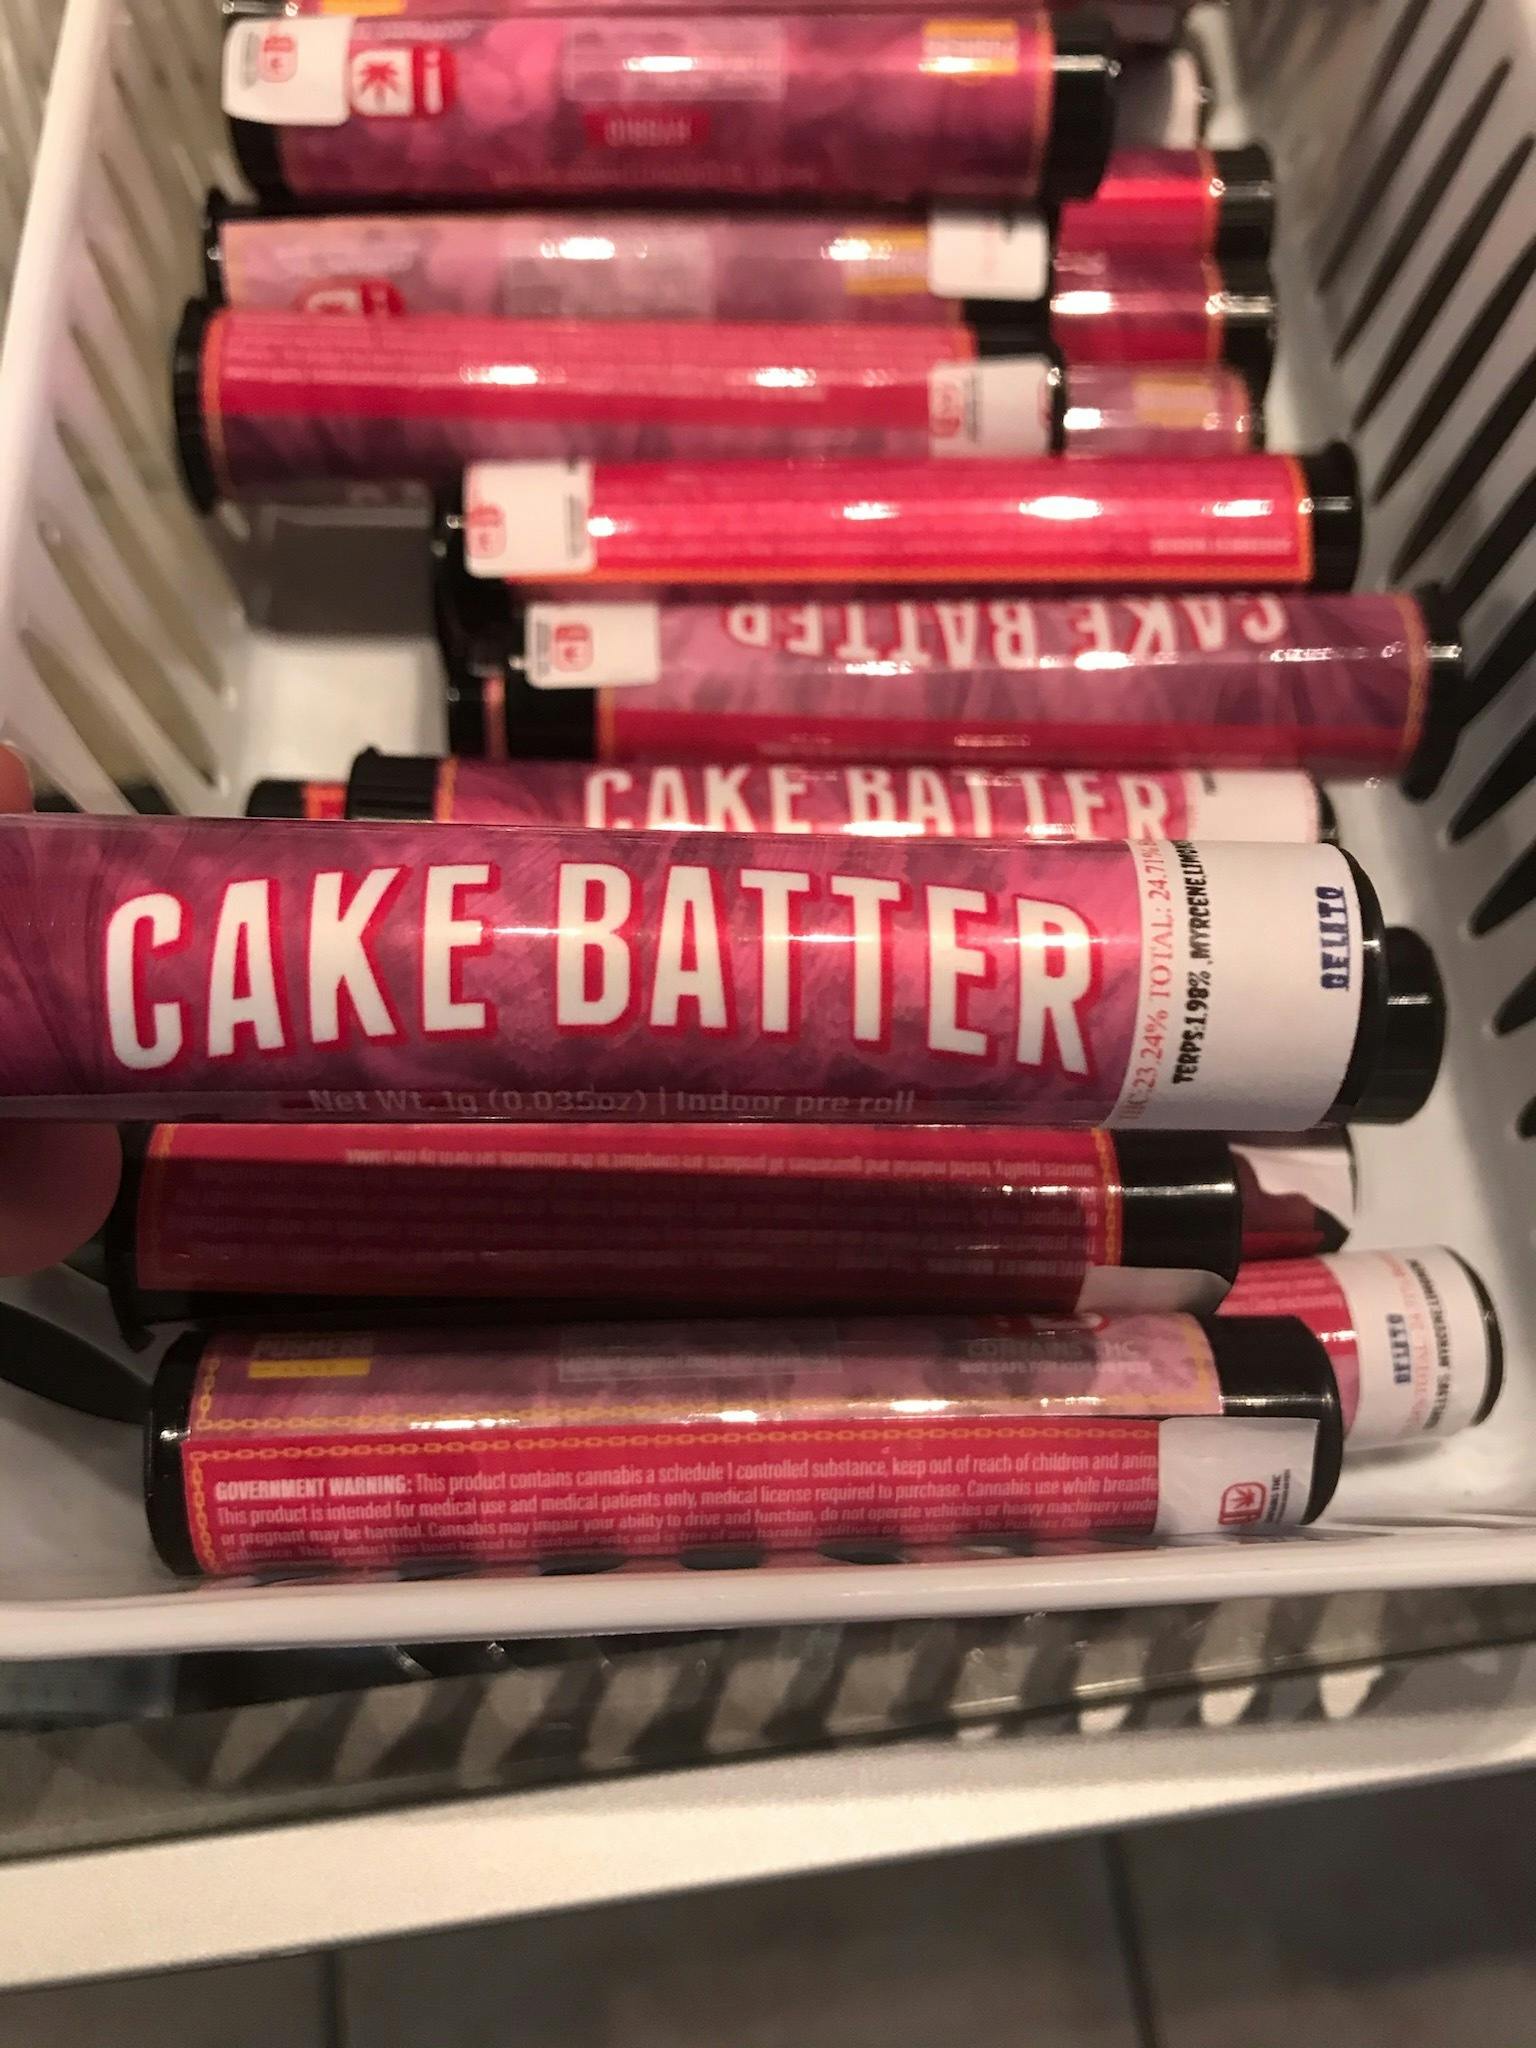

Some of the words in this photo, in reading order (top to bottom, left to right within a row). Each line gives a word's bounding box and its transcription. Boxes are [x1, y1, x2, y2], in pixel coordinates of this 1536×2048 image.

[585, 768, 811, 832] CAKE
[846, 768, 1170, 838] BATTER
[106, 864, 500, 1070] CAKE
[556, 862, 1096, 1077] BATTER
[1150, 907, 1174, 997] TOTAL:
[308, 1089, 369, 1112] Net
[677, 1090, 785, 1112] Indoor
[796, 1095, 850, 1115] pre
[858, 1090, 915, 1112] roll
[215, 1479, 325, 1501] GOVERNMENT
[329, 1474, 413, 1496] WARNING:
[416, 1472, 446, 1492] This
[449, 1470, 506, 1495] product
[510, 1469, 573, 1488] contains
[576, 1465, 643, 1486] cannabis
[646, 1469, 655, 1484] a
[658, 1461, 723, 1483] schedule
[736, 1459, 808, 1480] controlled
[811, 1457, 889, 1478] substance,
[892, 1456, 926, 1478] keep
[929, 1456, 953, 1474] out
[955, 1453, 970, 1474] of
[973, 1453, 1012, 1473] reach
[1015, 1452, 1029, 1472] of
[1032, 1451, 1089, 1471] children
[1092, 1451, 1119, 1469] and
[217, 1506, 247, 1526] This
[251, 1505, 307, 1527] product
[311, 1503, 324, 1522] is
[327, 1501, 392, 1521] intended
[395, 1500, 415, 1517] for
[419, 1498, 477, 1516] medical
[480, 1500, 506, 1514] use
[510, 1495, 537, 1513] and
[541, 1493, 598, 1511] medical
[601, 1492, 660, 1512] patients
[664, 1489, 697, 1510] only,
[701, 1486, 758, 1505] medical
[761, 1485, 812, 1503] license
[815, 1482, 875, 1504] required
[878, 1484, 892, 1499] to
[895, 1481, 965, 1503] purchase.
[967, 1478, 1031, 1497] Cannabis
[1034, 1480, 1060, 1494] use
[1062, 1476, 1100, 1494] while
[220, 1534, 236, 1547] or
[239, 1529, 305, 1547] pregnant
[309, 1529, 340, 1545] may
[343, 1526, 361, 1541] be
[428, 1519, 496, 1537] Cannabis
[499, 1520, 529, 1535] may
[583, 1517, 614, 1533] your
[618, 1511, 664, 1529] ability
[667, 1513, 681, 1527] to
[684, 1510, 721, 1526] drive
[724, 1509, 751, 1524] and
[820, 1507, 838, 1522] do
[841, 1506, 865, 1520] not
[868, 1506, 922, 1522] operate
[924, 1502, 981, 1518] vehicles
[1002, 1501, 1043, 1516] heavy
[1046, 1498, 1120, 1514] machinery
